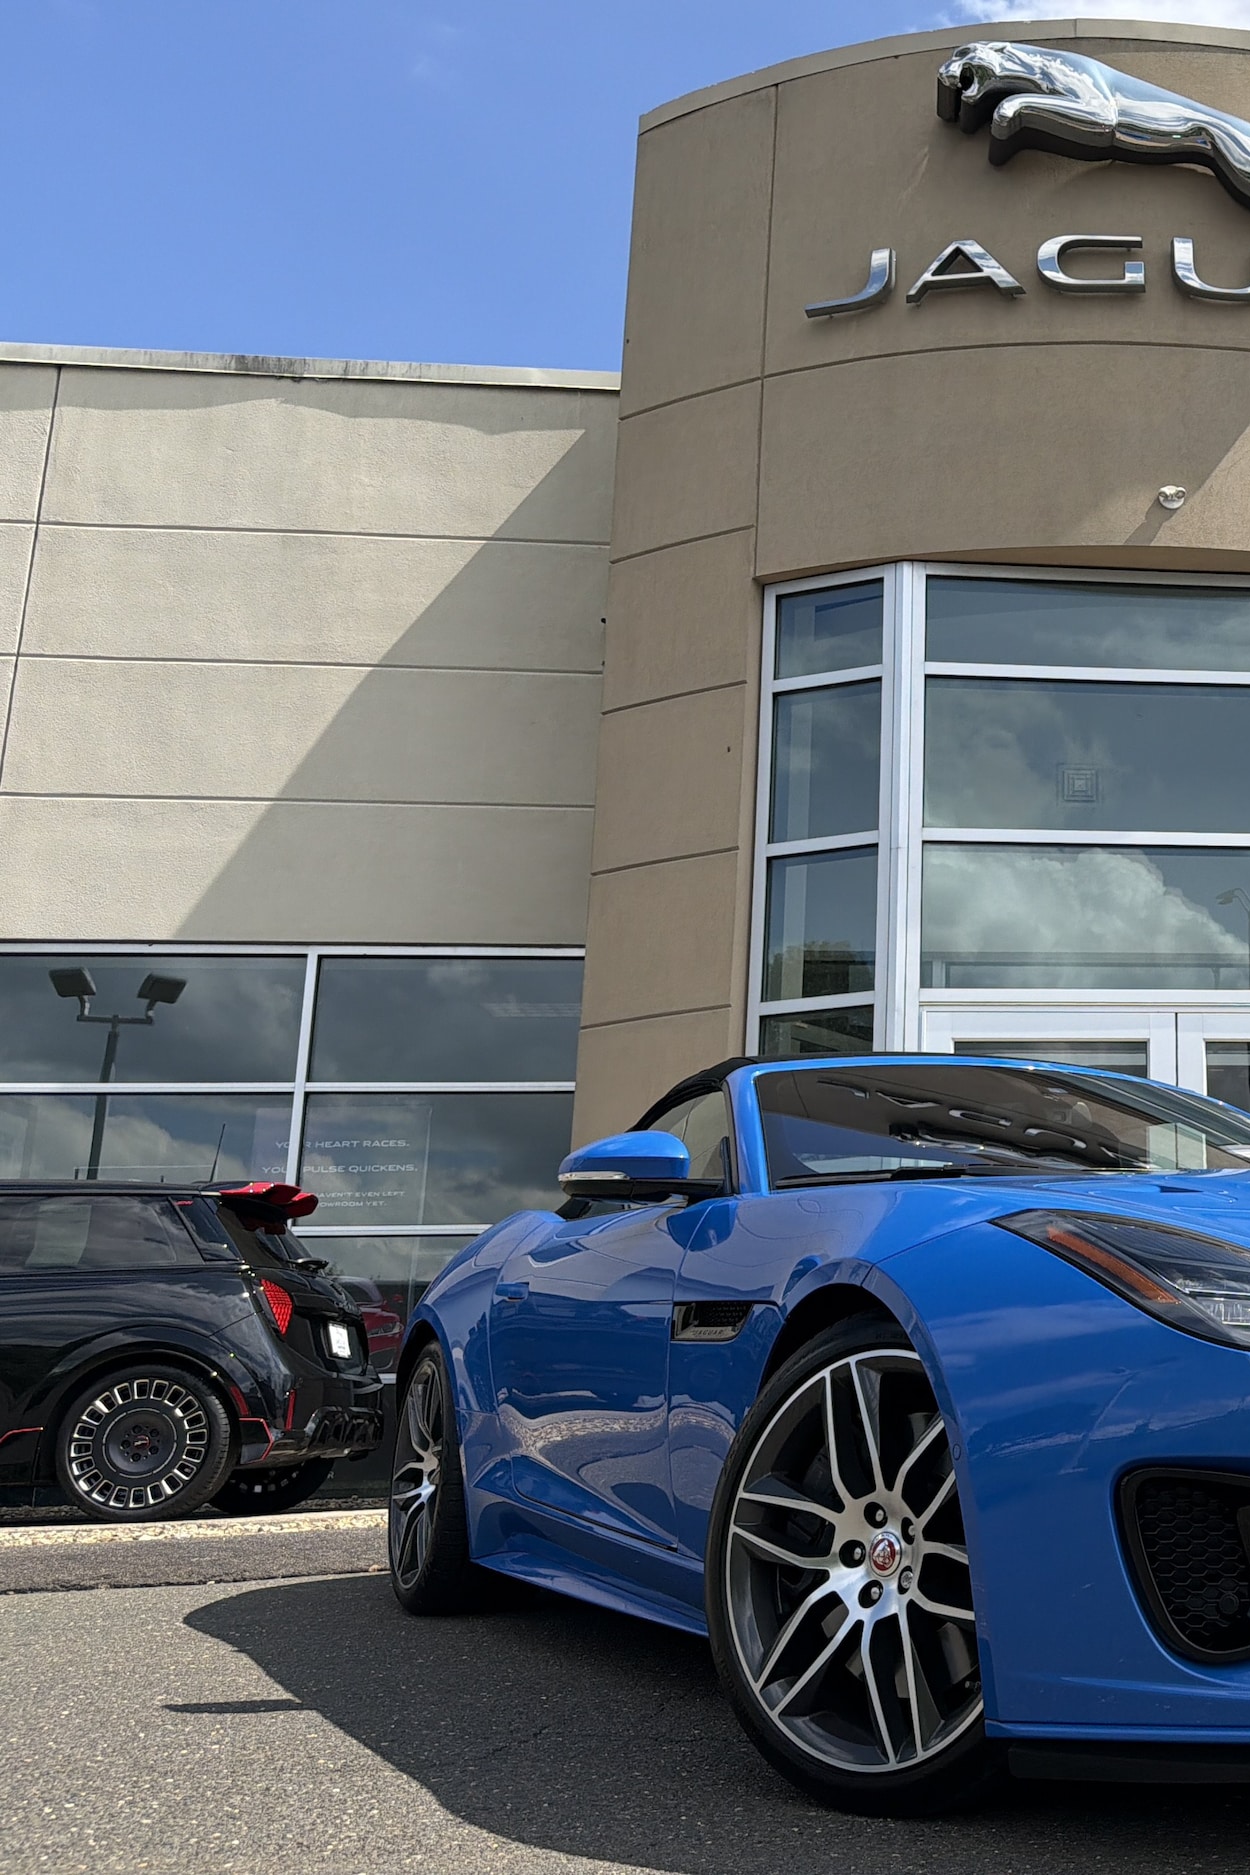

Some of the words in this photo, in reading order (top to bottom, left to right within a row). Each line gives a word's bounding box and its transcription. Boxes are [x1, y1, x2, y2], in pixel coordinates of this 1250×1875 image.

[316, 1140, 360, 1148] HEART
[363, 1139, 410, 1147] RACES.
[262, 1166, 288, 1175] YOU
[303, 1165, 345, 1173] PULSE
[349, 1164, 418, 1173] QUICKENS.
[366, 1200, 387, 1208] YET.
